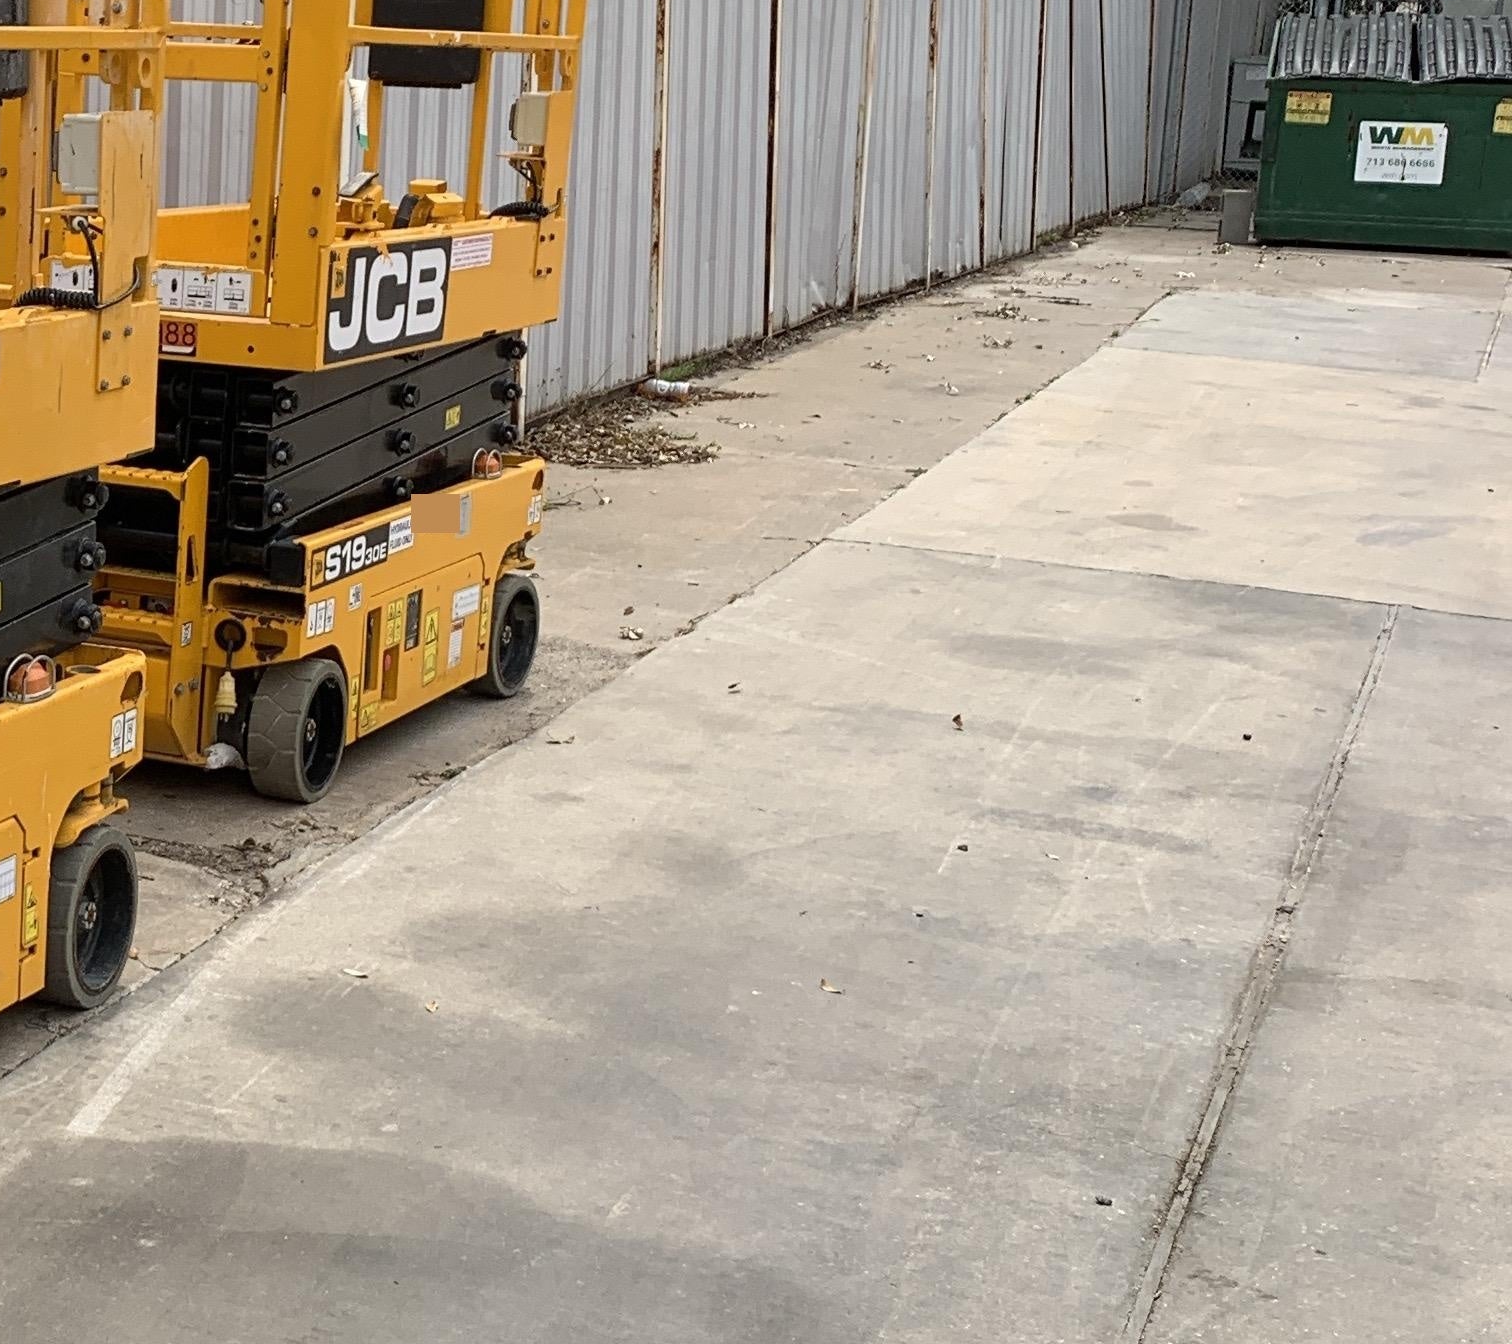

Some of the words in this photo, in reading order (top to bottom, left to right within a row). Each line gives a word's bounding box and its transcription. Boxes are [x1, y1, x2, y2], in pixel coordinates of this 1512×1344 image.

[1369, 126, 1434, 145] WM
[328, 247, 447, 352] JCB
[159, 322, 196, 347] 88
